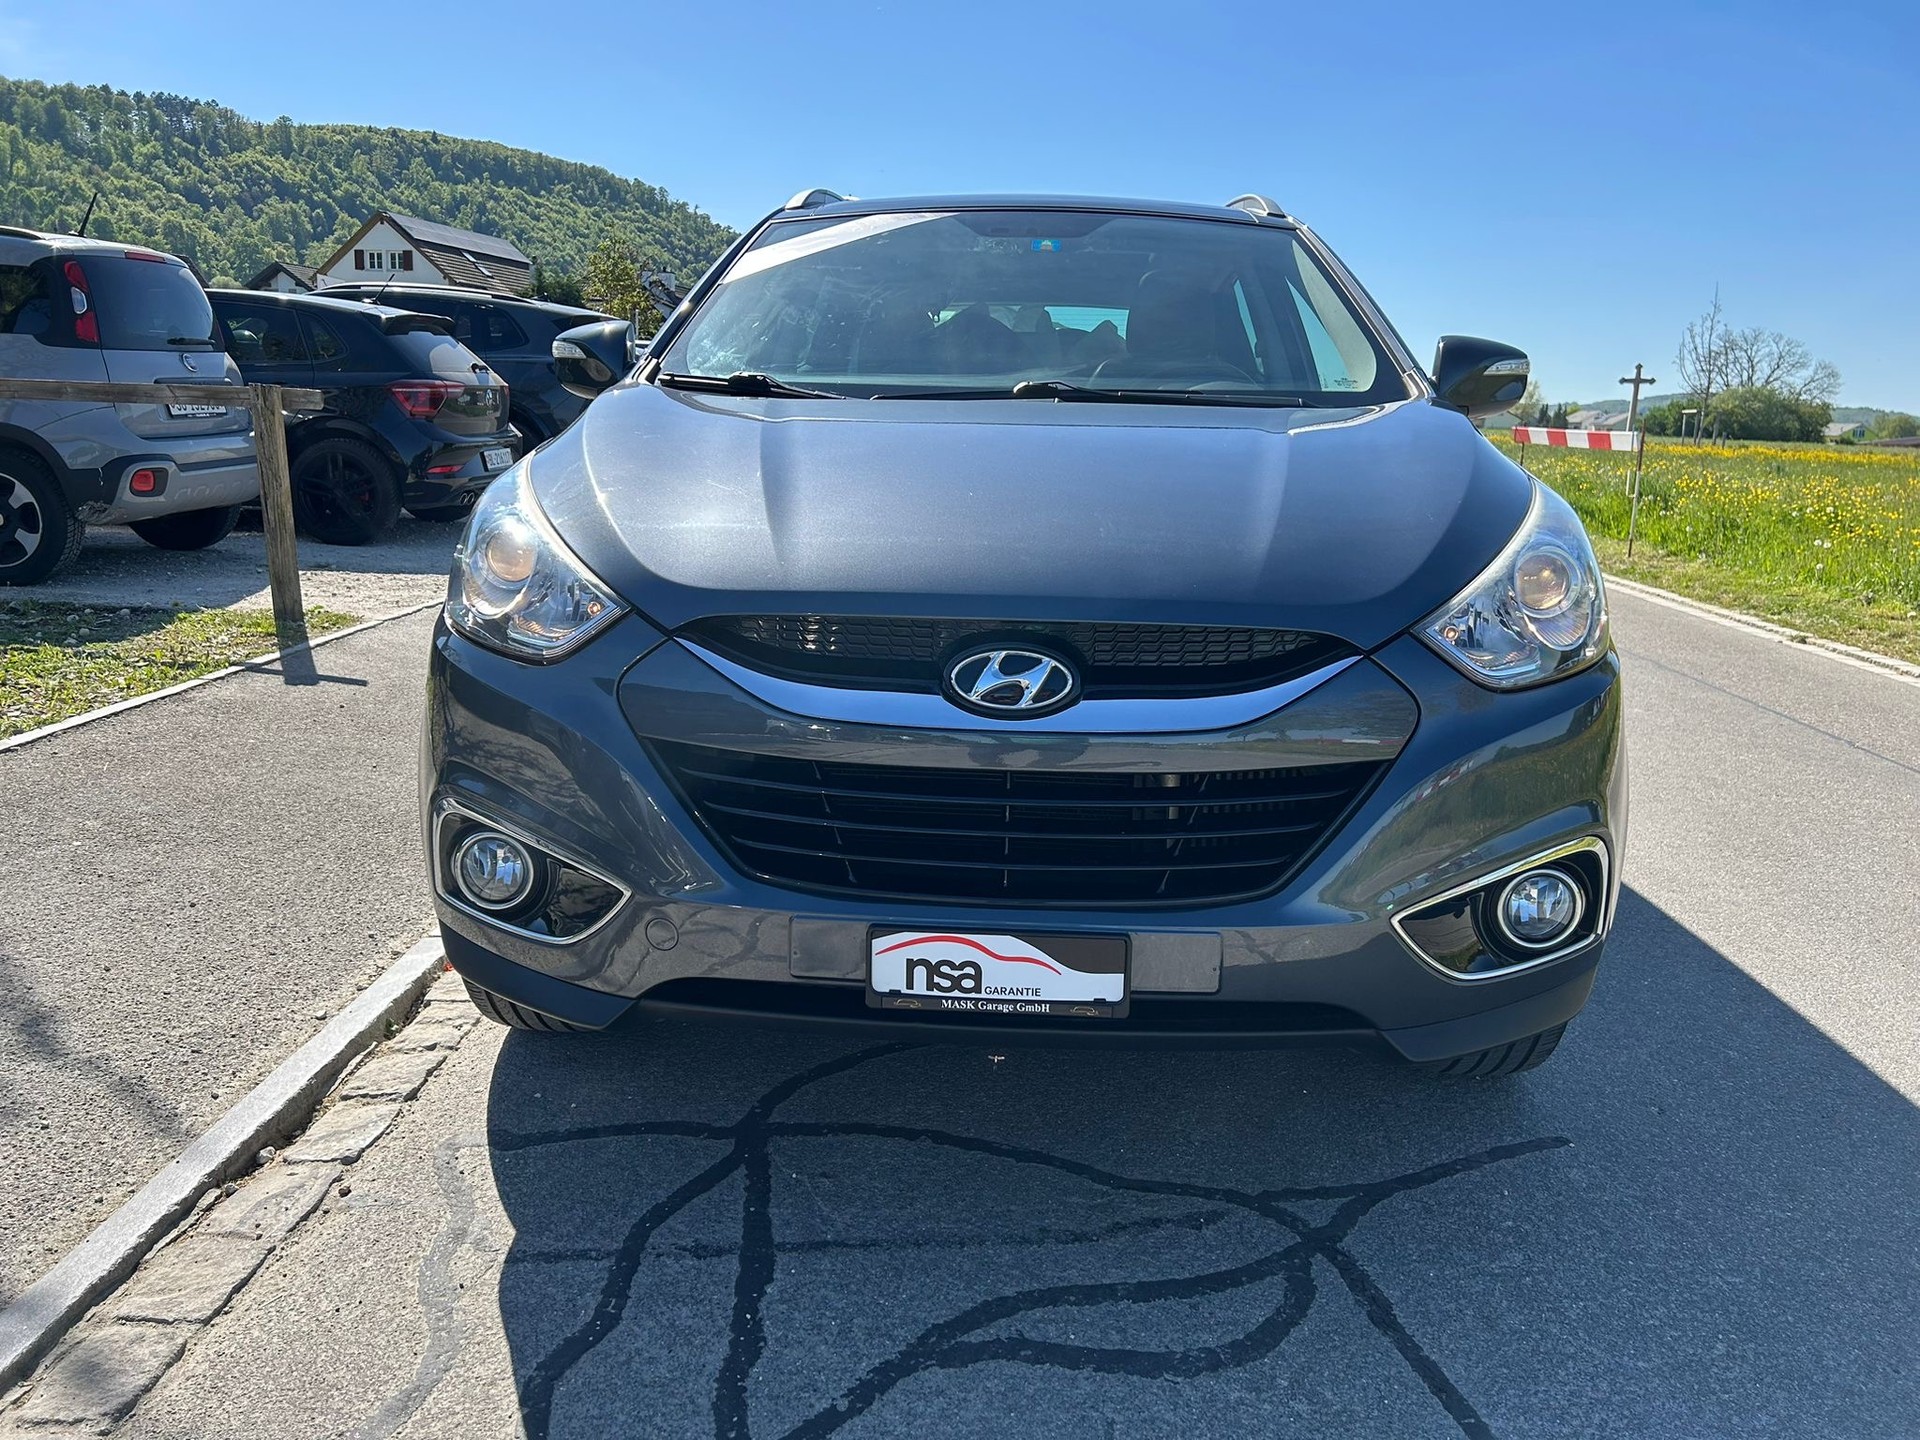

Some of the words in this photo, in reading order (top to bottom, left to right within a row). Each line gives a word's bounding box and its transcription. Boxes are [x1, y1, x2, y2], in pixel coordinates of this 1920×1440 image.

[905, 958, 982, 994] nsa
[984, 986, 1041, 997] GARANTIE
[941, 999, 975, 1010] MASK
[977, 1001, 1014, 1013] Garage
[1016, 1002, 1050, 1013] GmbH
